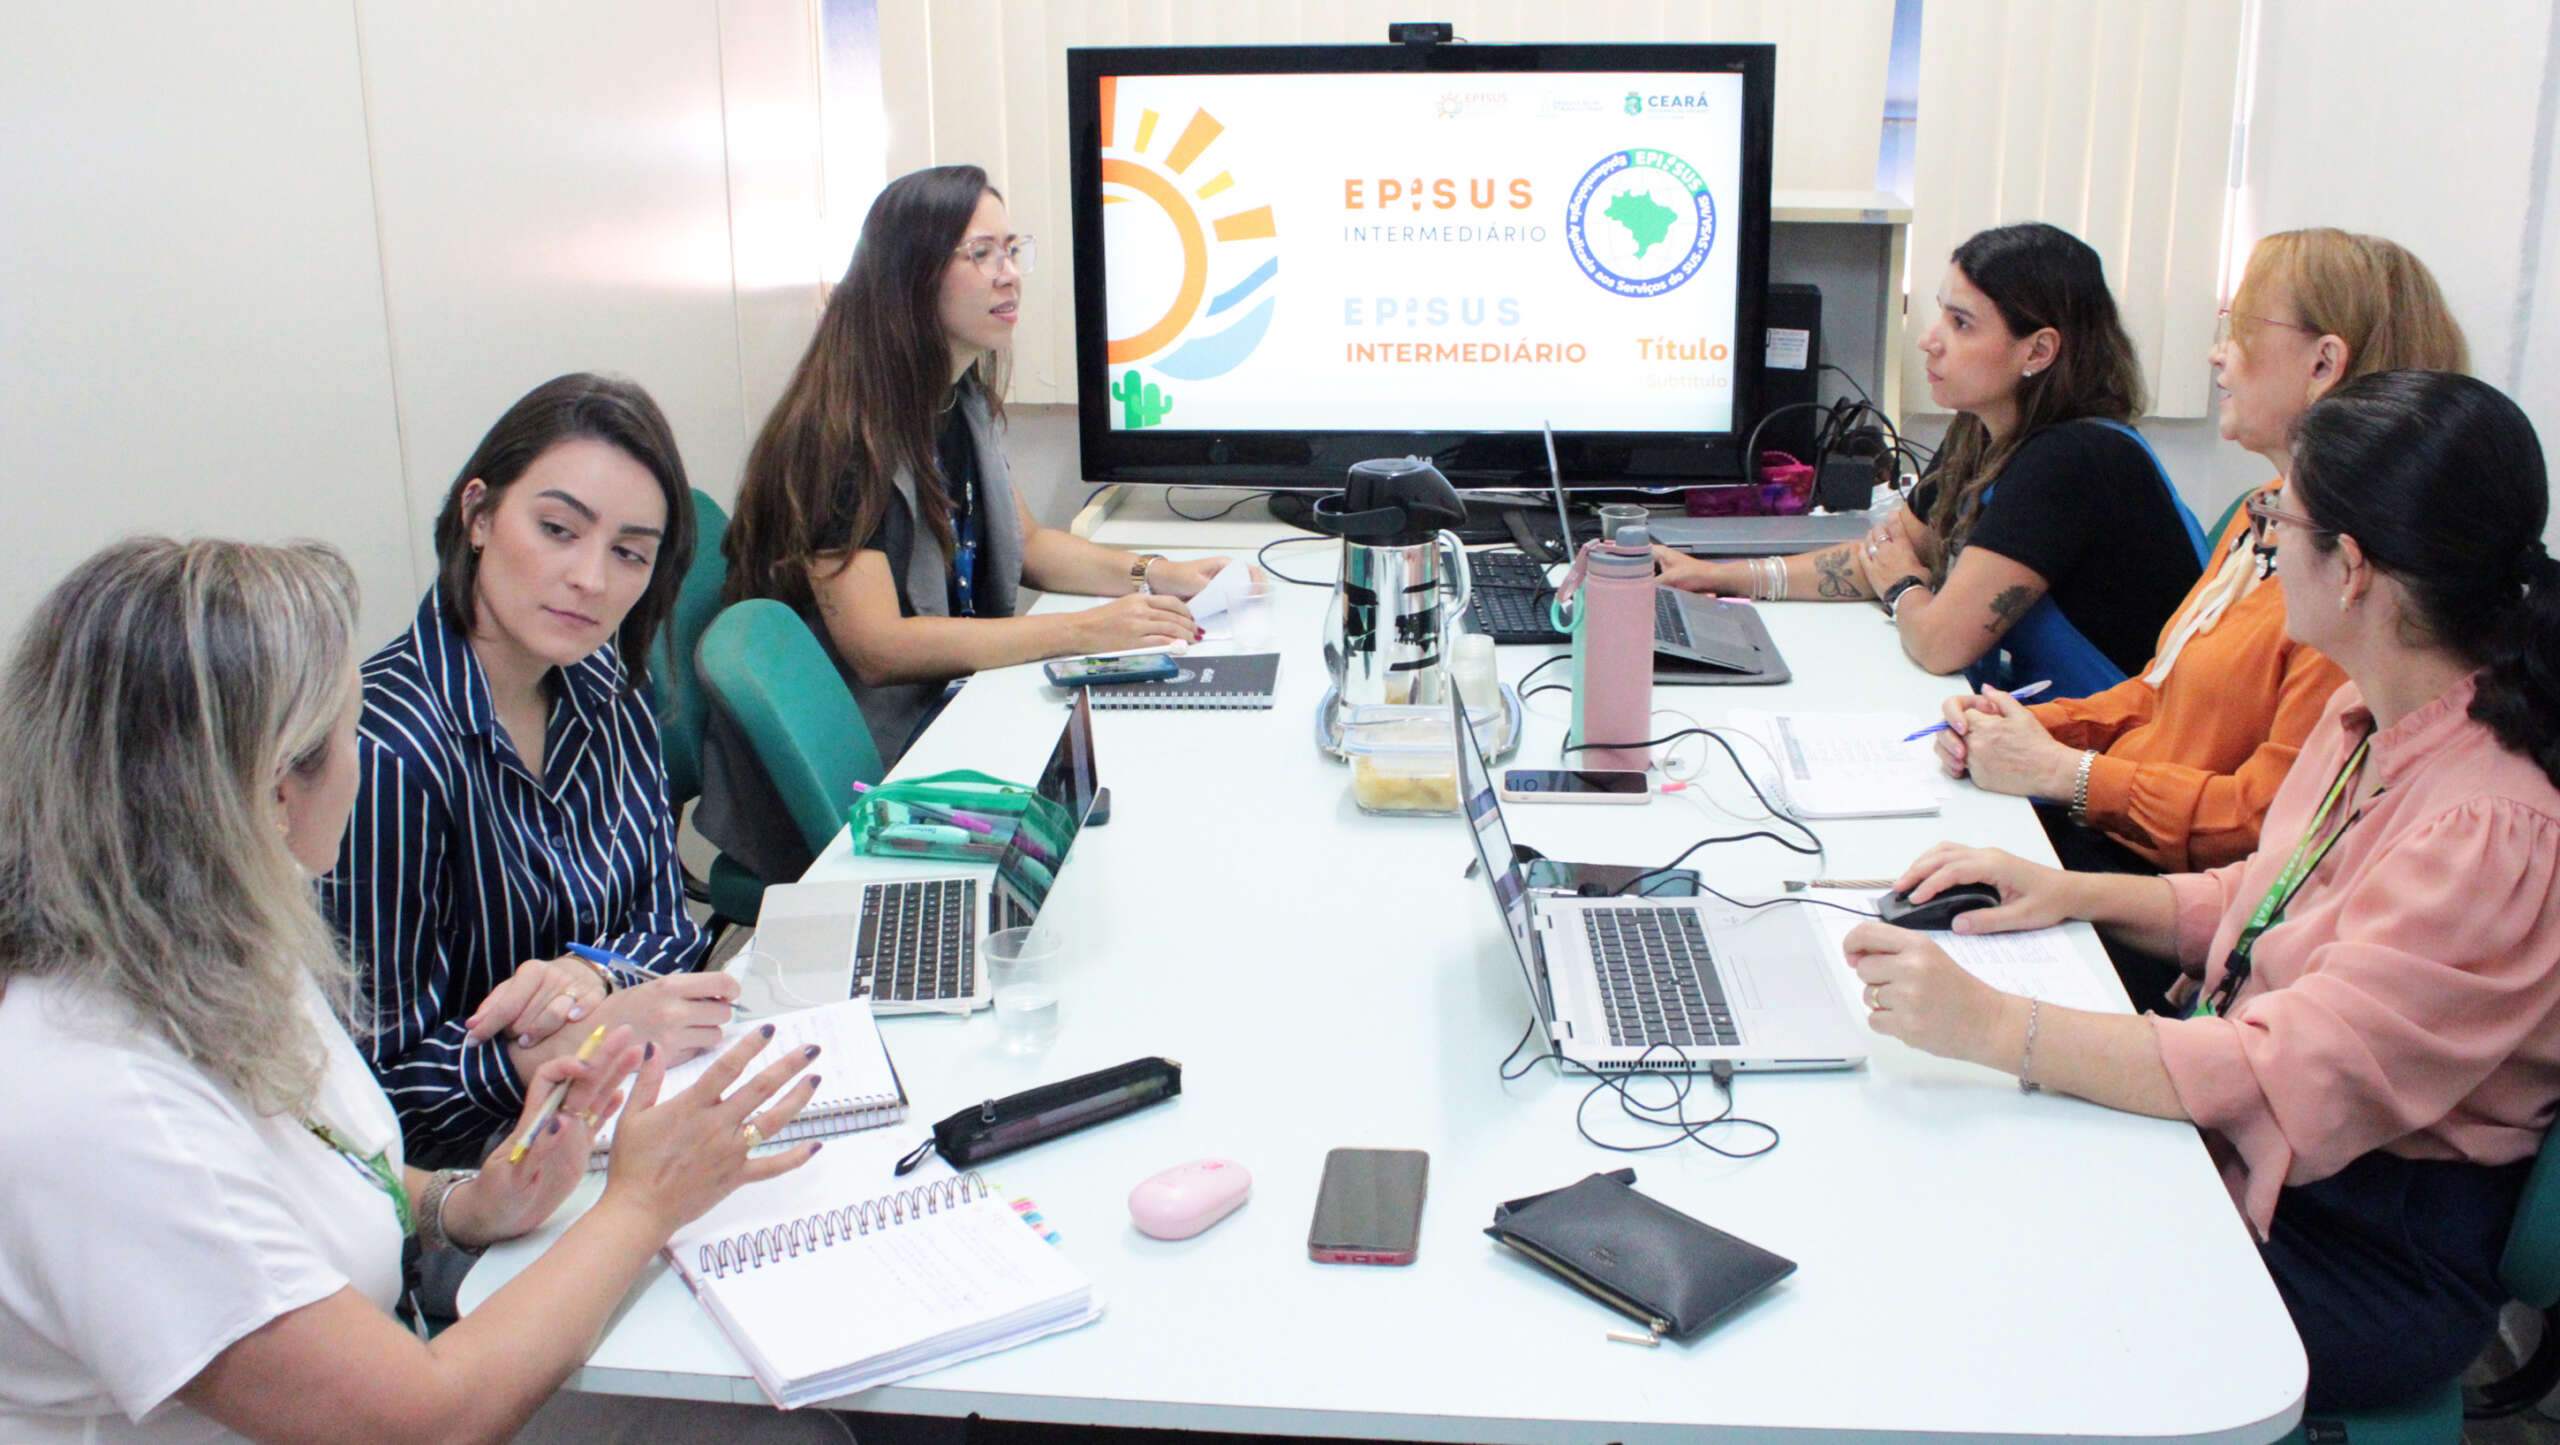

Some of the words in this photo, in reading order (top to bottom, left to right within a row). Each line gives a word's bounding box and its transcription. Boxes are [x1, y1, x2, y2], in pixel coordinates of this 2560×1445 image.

[1648, 91, 1709, 108] CEARÁ
[1570, 153, 1628, 222] Epidemiologia
[1344, 222, 1547, 242] INTERMEDIÁRIO
[1569, 225, 1597, 274] Aplicada
[1594, 270, 1615, 287] aos
[1615, 280, 1667, 296] Serviços
[1667, 271, 1683, 286] do
[1346, 338, 1587, 363] INTERMEDIÁRIO
[1637, 336, 1729, 362] Título
